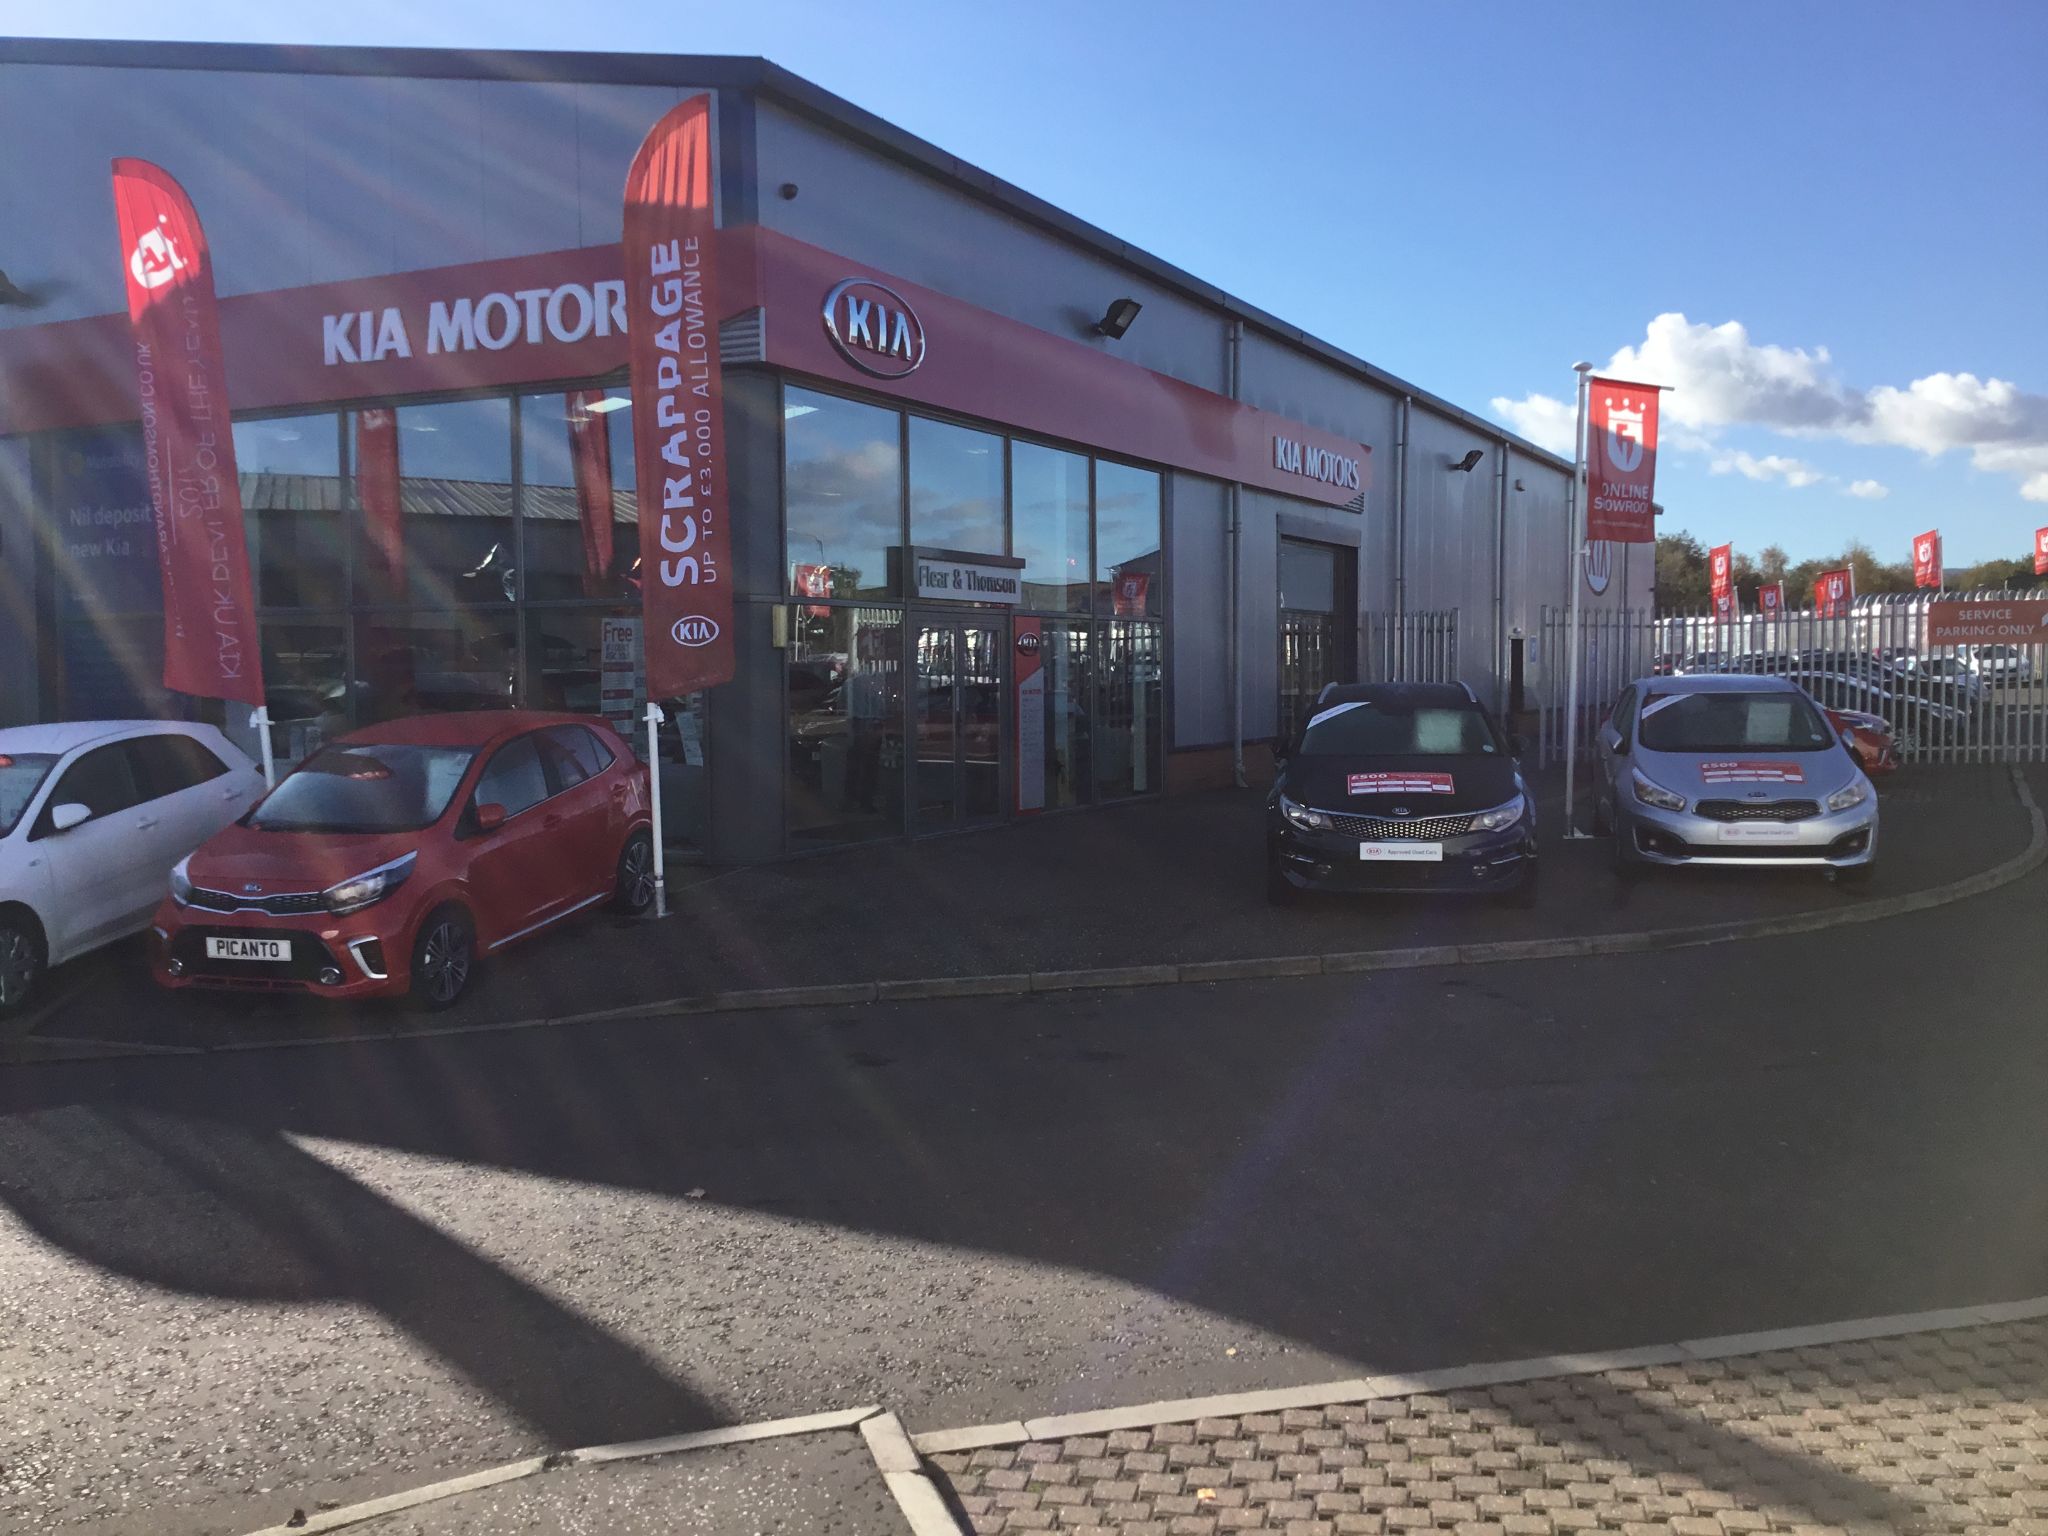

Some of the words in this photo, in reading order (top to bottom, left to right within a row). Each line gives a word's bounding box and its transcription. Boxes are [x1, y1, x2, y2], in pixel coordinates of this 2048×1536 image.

[323, 308, 413, 366] KIA
[427, 280, 628, 355] MOTOR
[684, 236, 709, 398] ALLOWANCE
[846, 295, 912, 361] KIA
[651, 239, 698, 587] SCRAPPAGE
[1276, 437, 1302, 475] KIA
[1306, 445, 1360, 491] MOTORS
[95, 504, 152, 529] deposit
[1593, 496, 1649, 514] SOWROO
[702, 508, 713, 541] TO
[703, 551, 717, 583] UP
[919, 565, 949, 589] Flear
[953, 569, 962, 589] &
[966, 570, 1016, 594] Thomson
[1958, 608, 2012, 621] SERVICE
[603, 621, 633, 642] Free
[1936, 625, 1995, 637] PARKING
[1998, 624, 2035, 636] ONLY
[216, 939, 280, 958] PICANTO
